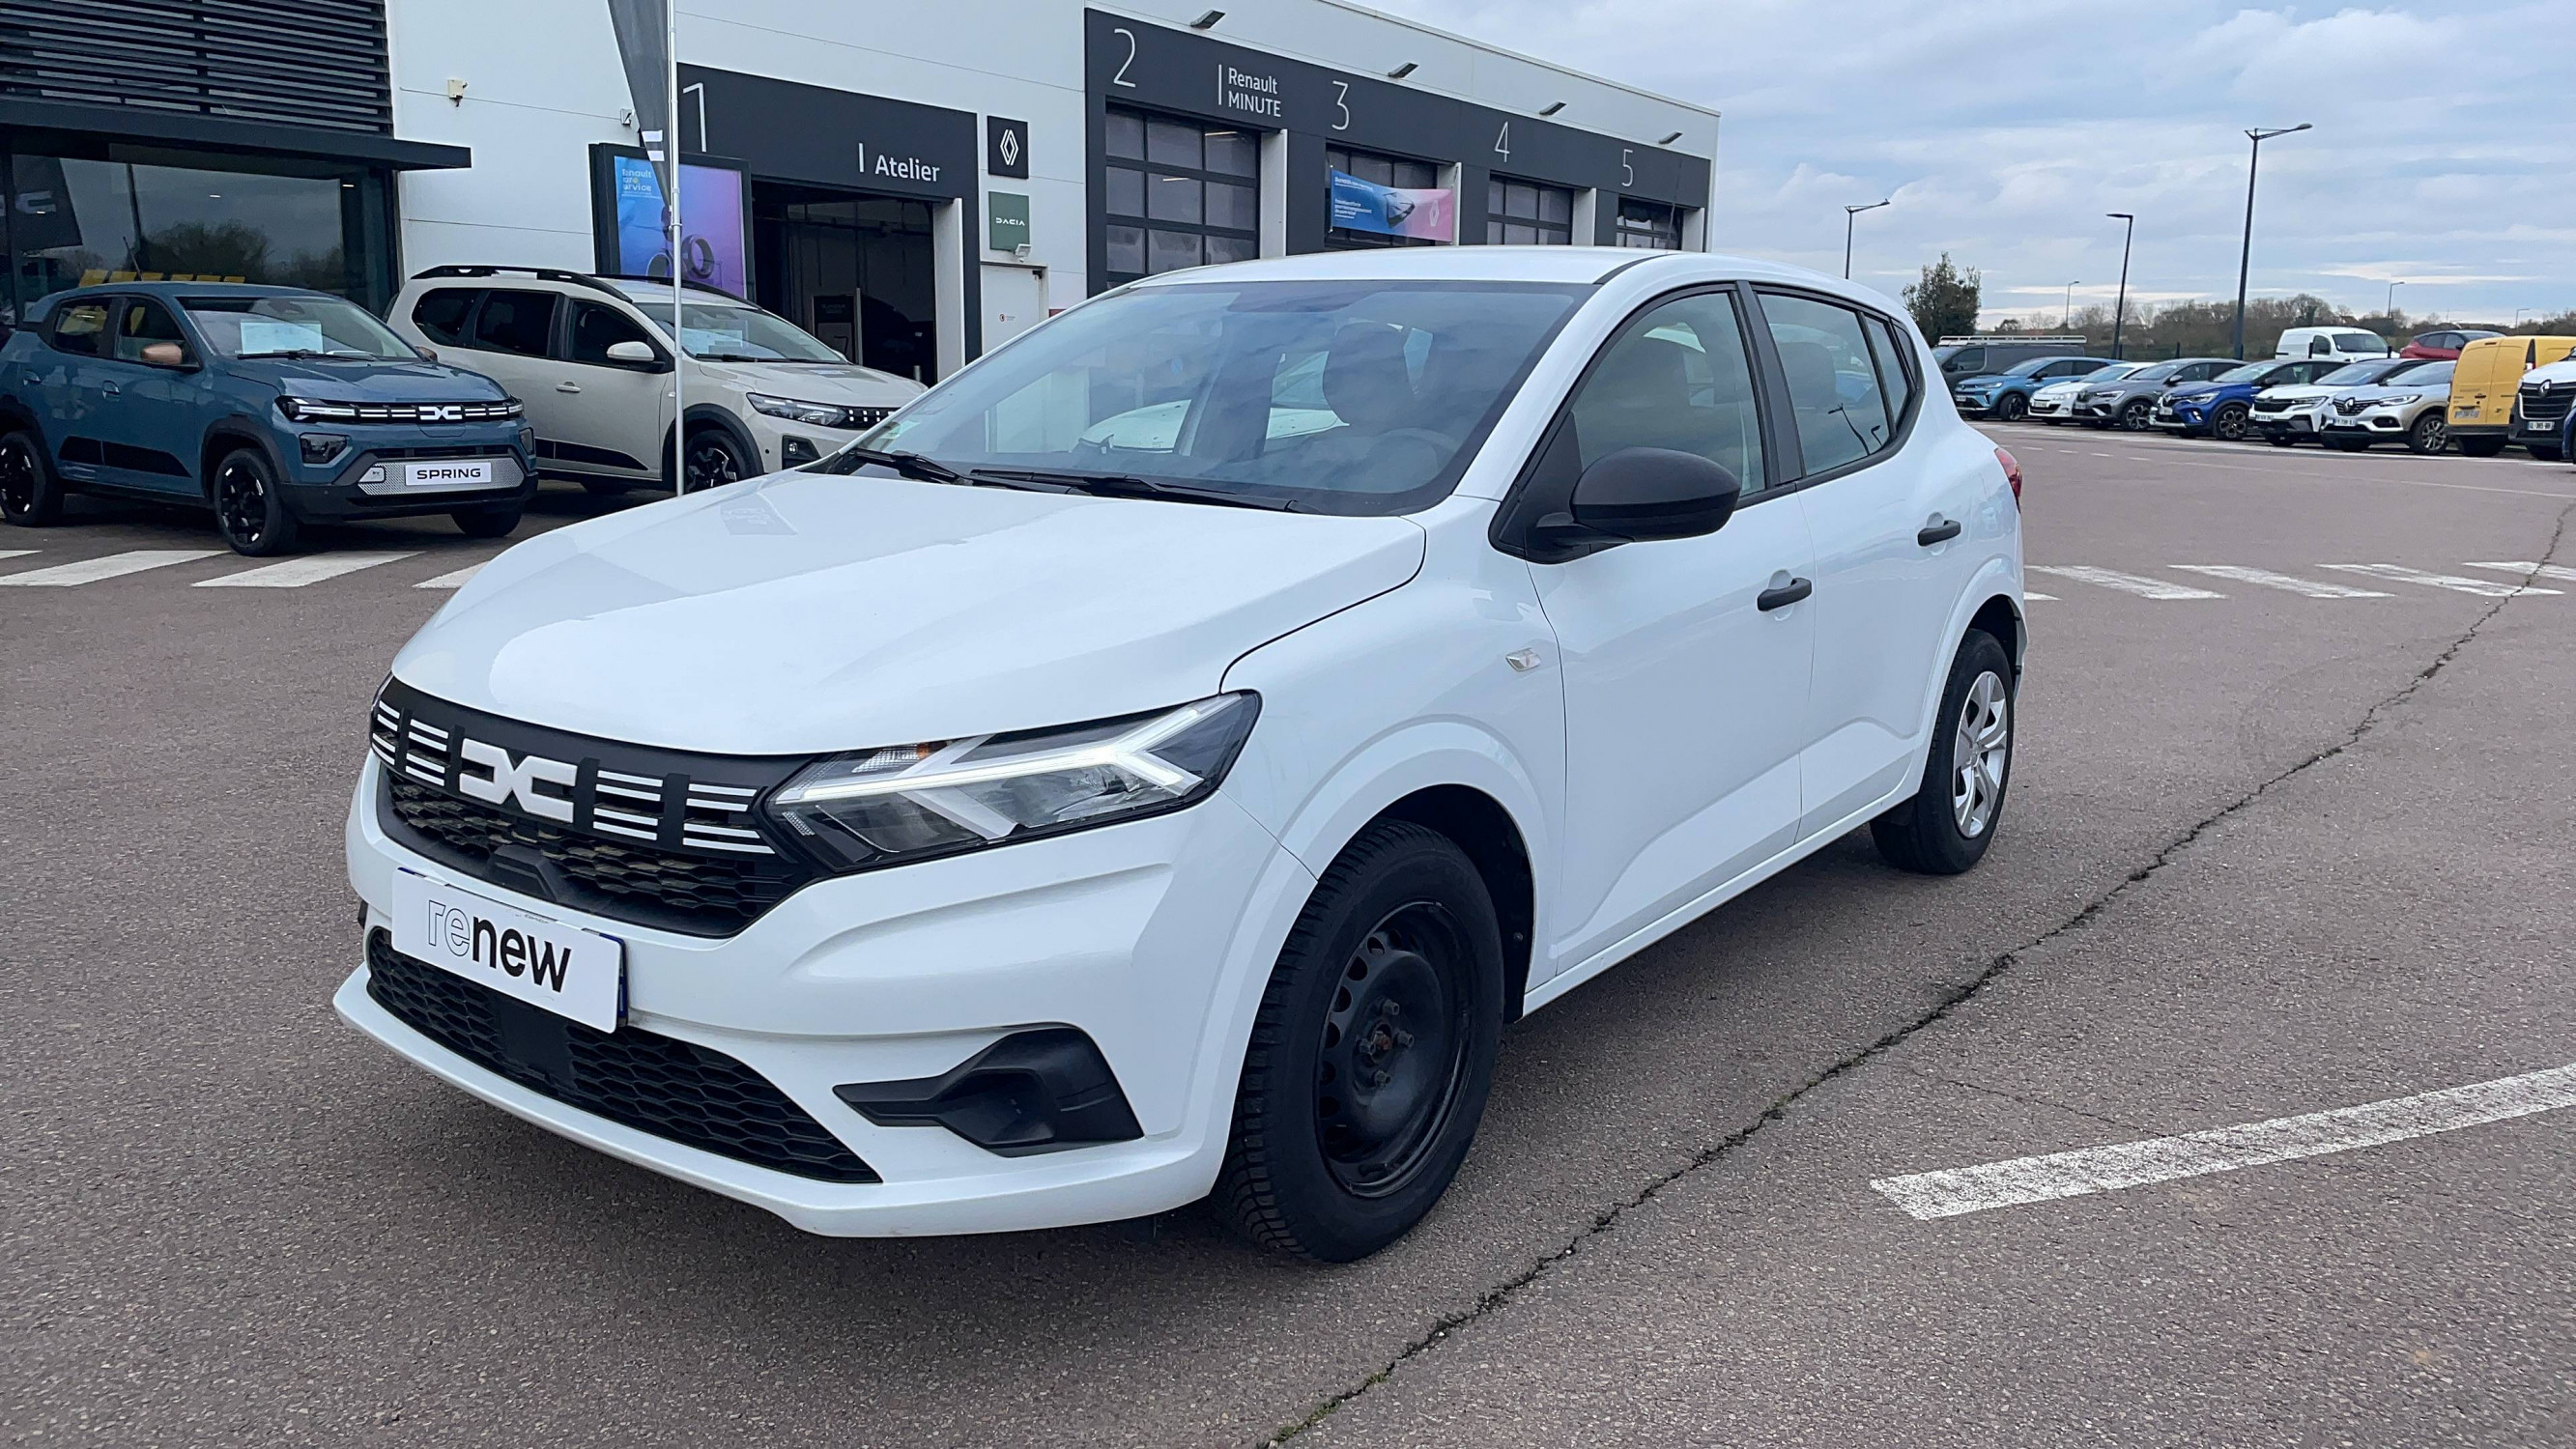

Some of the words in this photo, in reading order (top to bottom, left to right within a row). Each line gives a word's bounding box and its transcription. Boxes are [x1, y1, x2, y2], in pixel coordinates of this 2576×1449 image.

[1113, 28, 1136, 88] 2
[1228, 67, 1278, 95] Renault
[683, 82, 707, 153] 1
[1228, 90, 1282, 118] MINUTE
[1331, 80, 1351, 131] 3
[1494, 121, 1510, 163] 4
[874, 154, 940, 183] Atelier
[1620, 148, 1634, 187] 5
[995, 216, 1026, 226] DACIA
[416, 468, 481, 480] SPRING
[427, 899, 572, 993] renew
